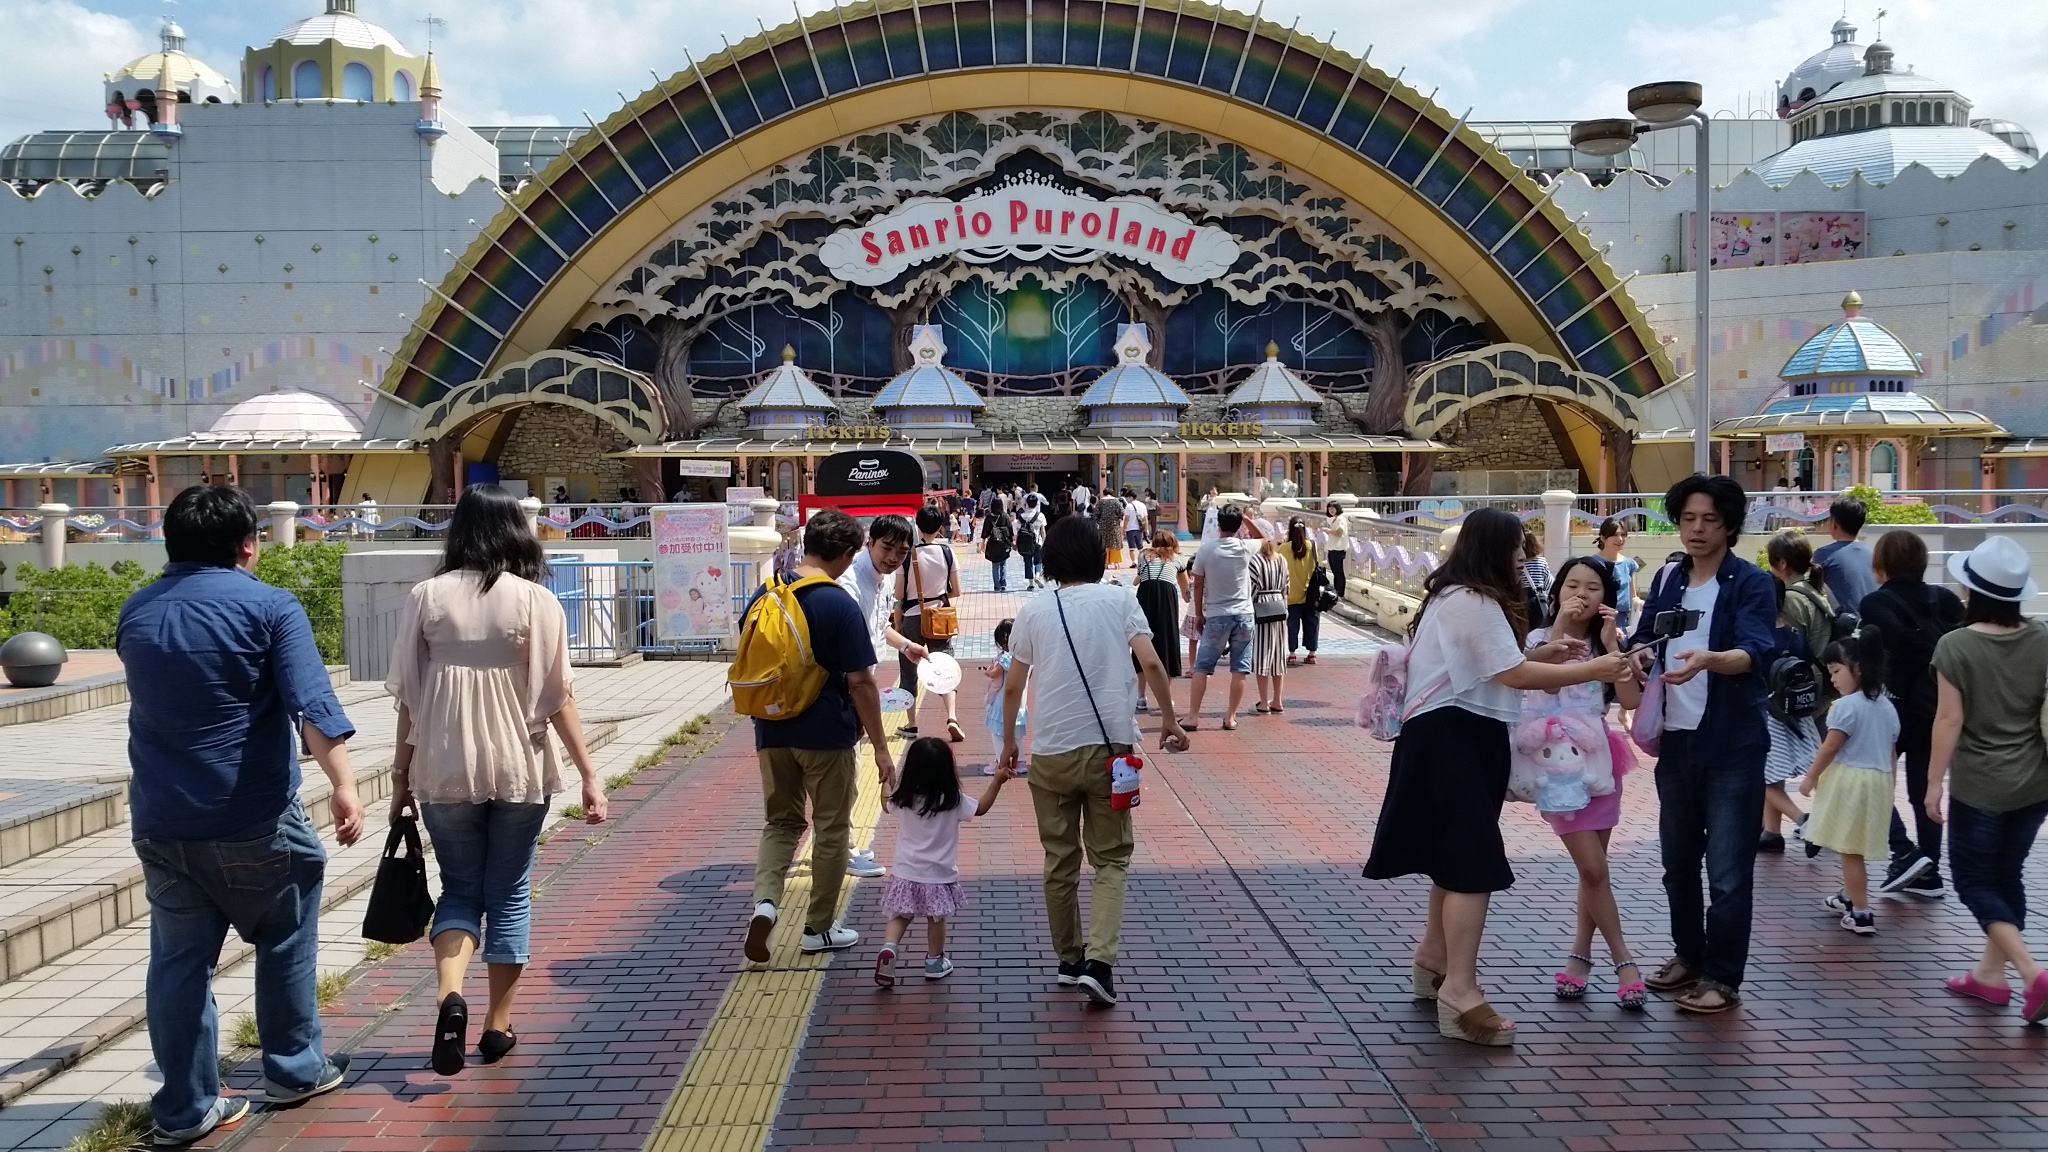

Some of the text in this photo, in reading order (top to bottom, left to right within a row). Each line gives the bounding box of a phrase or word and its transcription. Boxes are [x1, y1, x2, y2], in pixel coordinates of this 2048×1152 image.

[861, 199, 1196, 266] Sanrio Puroland
[806, 425, 891, 439] TICKETS
[1178, 421, 1263, 436] TICKETS
[848, 467, 889, 480] Paninox
